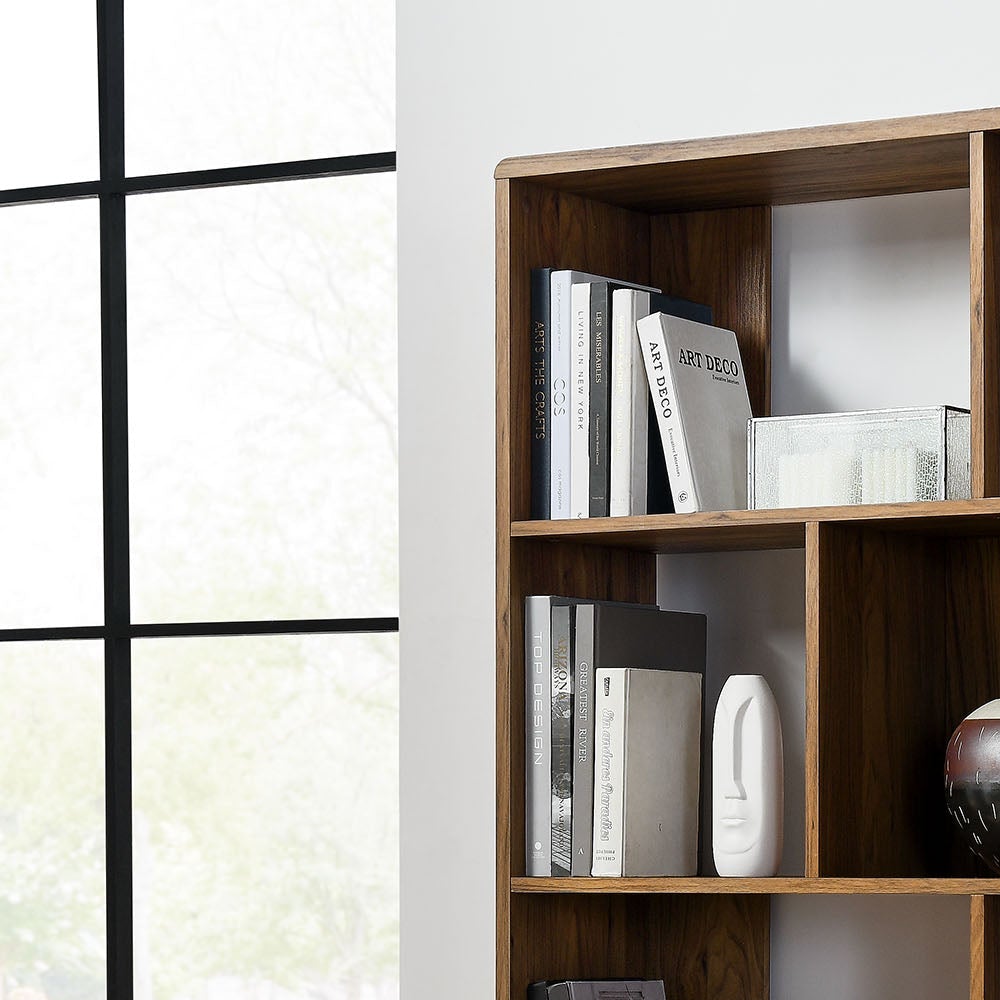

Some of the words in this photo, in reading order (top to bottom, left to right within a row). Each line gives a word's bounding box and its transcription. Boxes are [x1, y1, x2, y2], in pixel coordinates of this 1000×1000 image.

[534, 322, 545, 354] ARTS
[535, 358, 545, 386] THE
[577, 354, 584, 365] IN
[678, 348, 702, 368] ART
[705, 354, 739, 377] DECO
[553, 378, 566, 417] COS
[649, 341, 663, 374] ART
[656, 377, 672, 419] DECO
[535, 391, 546, 440] CRAFTS
[533, 631, 543, 674] TOP
[579, 661, 589, 720] GREATEST
[533, 683, 543, 766] DESIGN
[578, 728, 588, 764] RIVER
